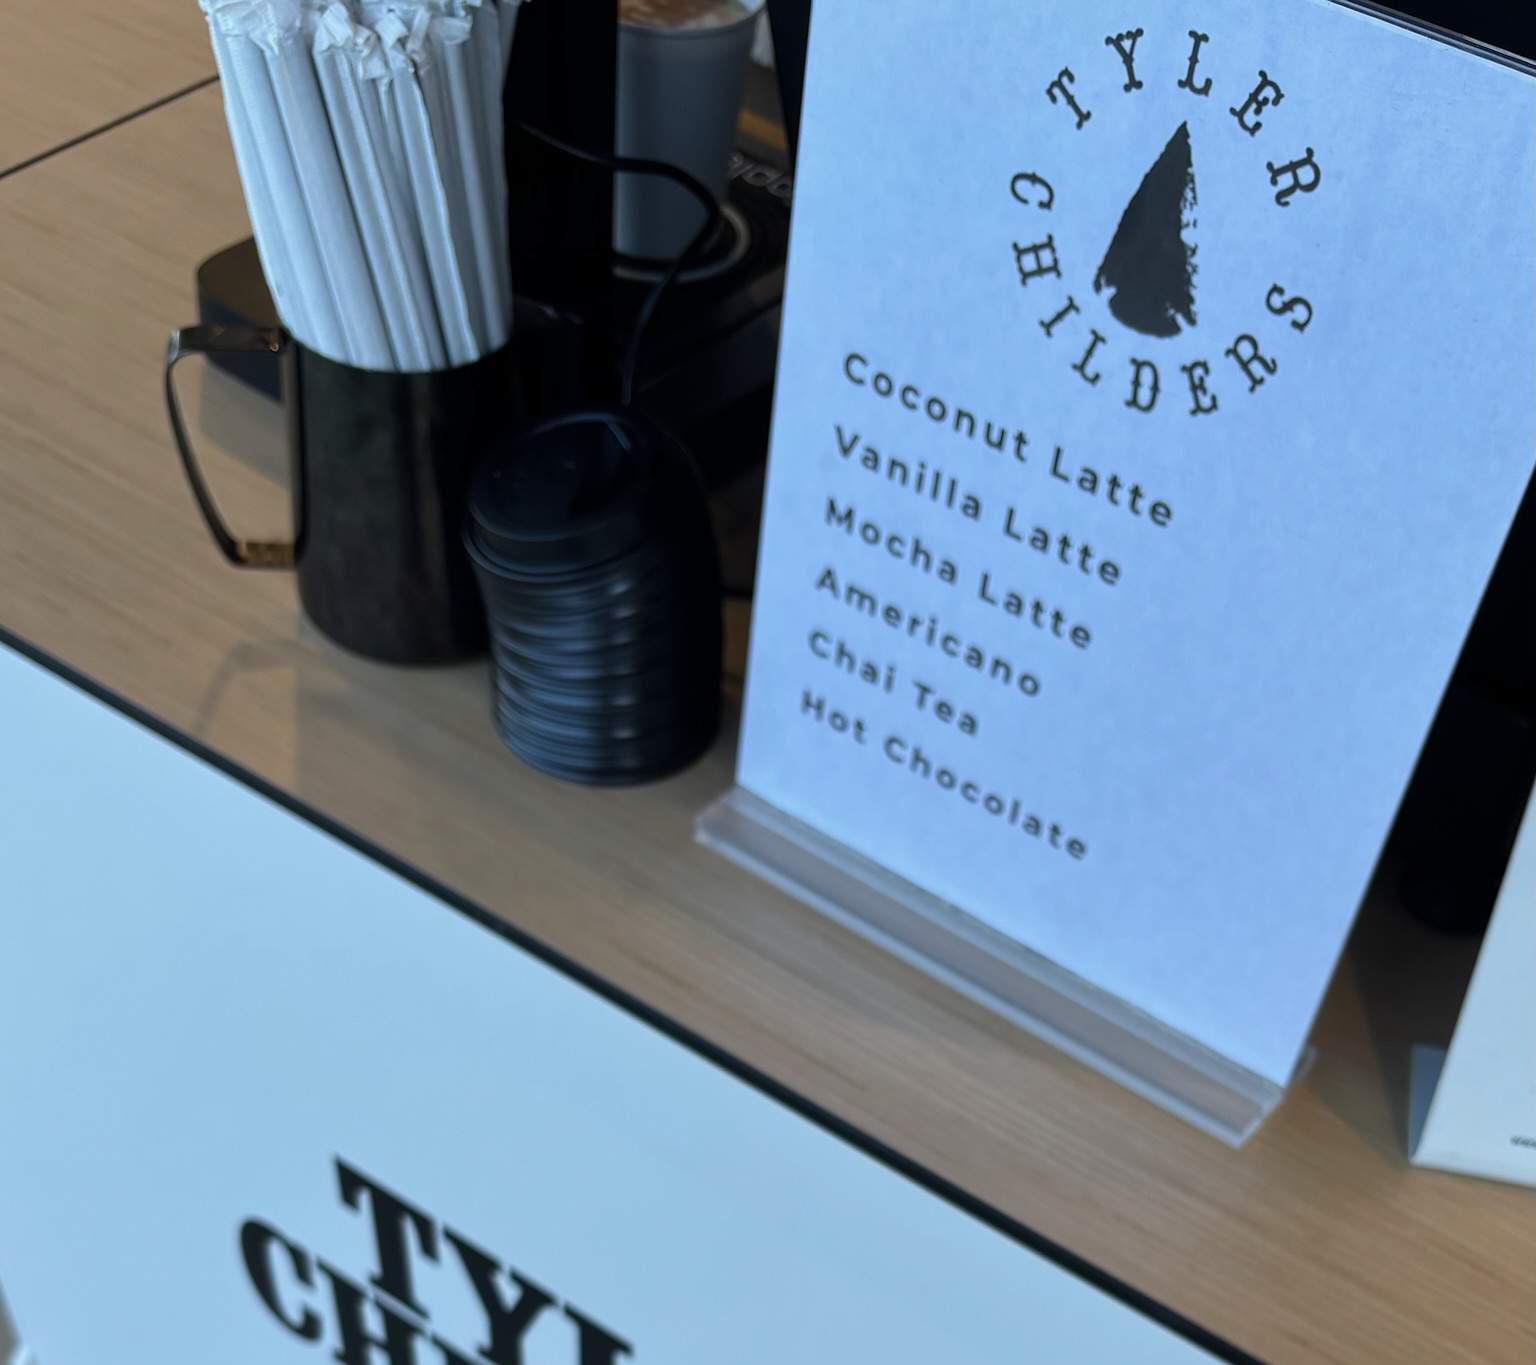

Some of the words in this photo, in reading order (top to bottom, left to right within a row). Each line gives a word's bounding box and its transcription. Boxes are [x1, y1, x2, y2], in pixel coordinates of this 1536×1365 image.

[1045, 27, 1322, 208] TYLER
[1010, 170, 1314, 417] CHILDERS
[834, 424, 983, 522] Vanilla
[1003, 506, 1121, 587] Latte
[843, 352, 1029, 462] Coconut
[1050, 446, 1173, 528] Latte
[814, 566, 1042, 698] Americano
[825, 497, 959, 586] Mocha
[978, 571, 1092, 650] Latte
[807, 629, 897, 693] Chai
[913, 680, 979, 737] Tea
[801, 689, 867, 745] Hot
[882, 735, 1088, 861] Chocolate
